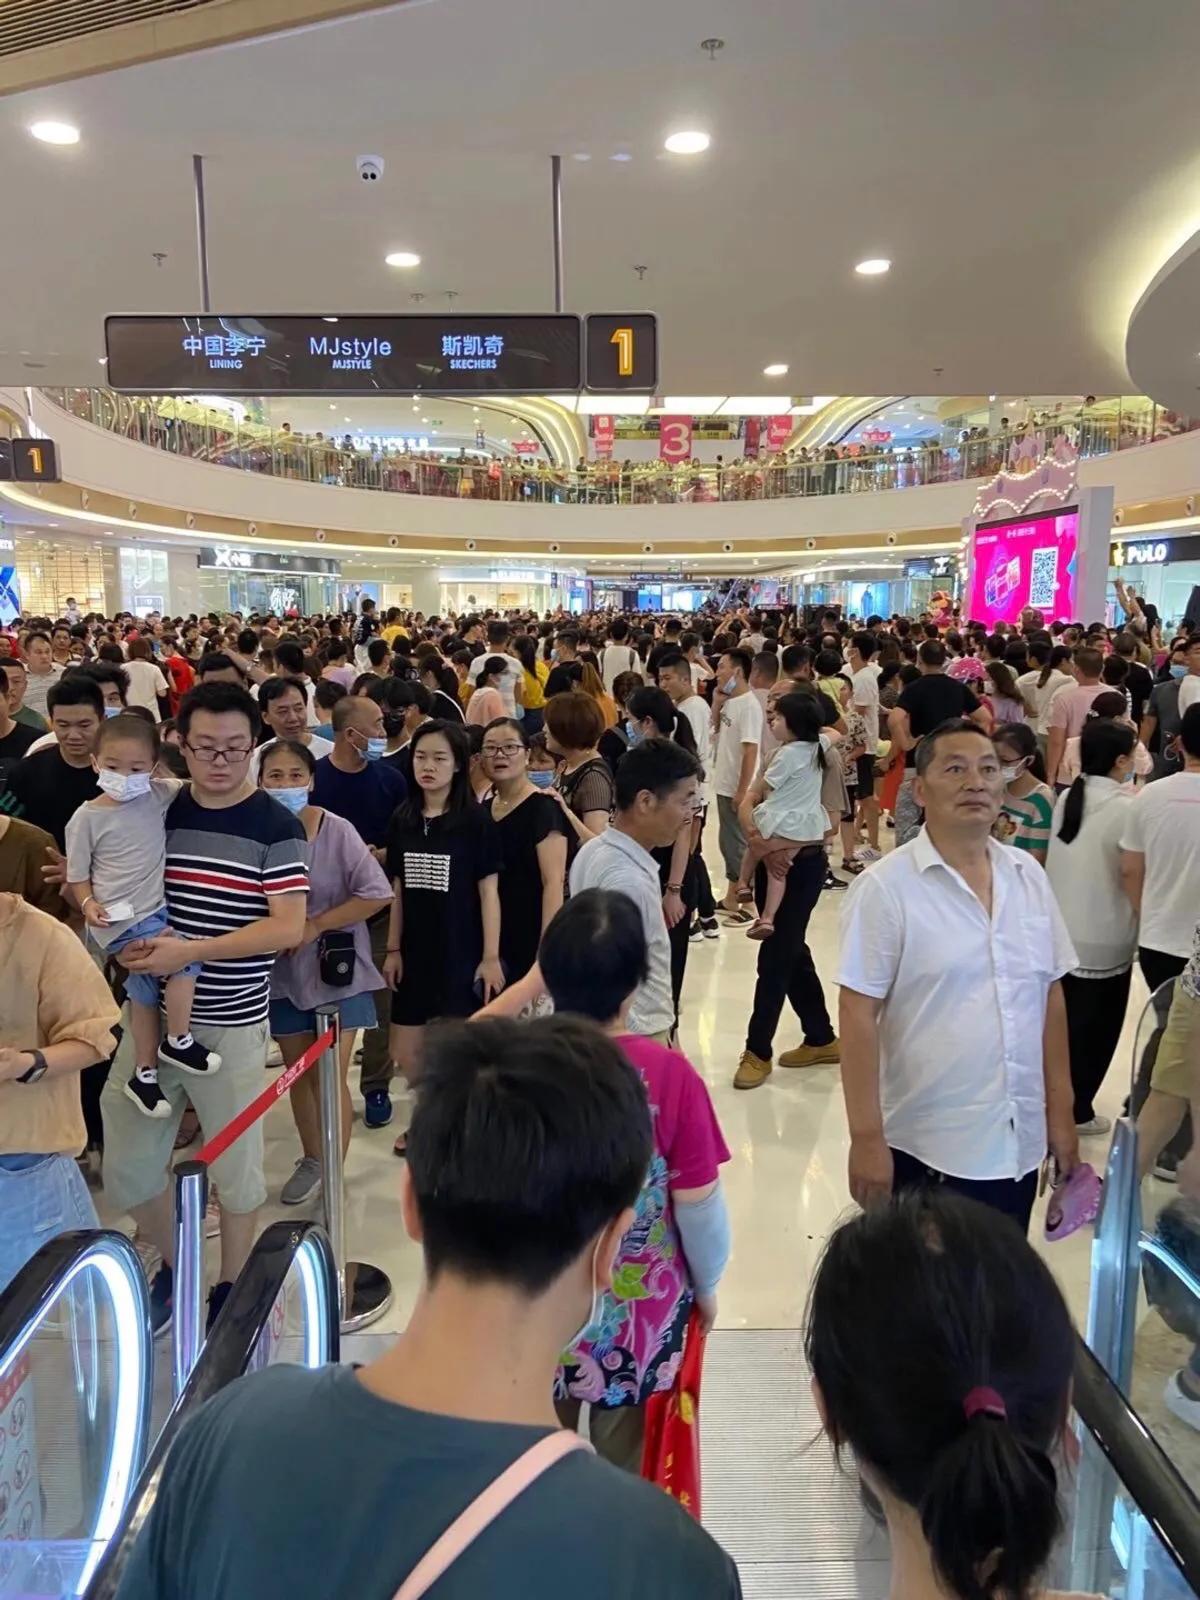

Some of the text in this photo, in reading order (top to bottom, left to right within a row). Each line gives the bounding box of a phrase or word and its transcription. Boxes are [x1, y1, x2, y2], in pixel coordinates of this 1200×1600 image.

[183, 335, 266, 356] 中国李宁
[310, 337, 392, 359] MJstyle
[442, 335, 504, 356] 斯凯奇
[610, 328, 633, 376] 1
[209, 359, 243, 369] LINING
[332, 359, 372, 370] MJSTYLE
[450, 359, 497, 370] SKECHERS
[663, 423, 690, 456] 3
[27, 447, 42, 473] 1
